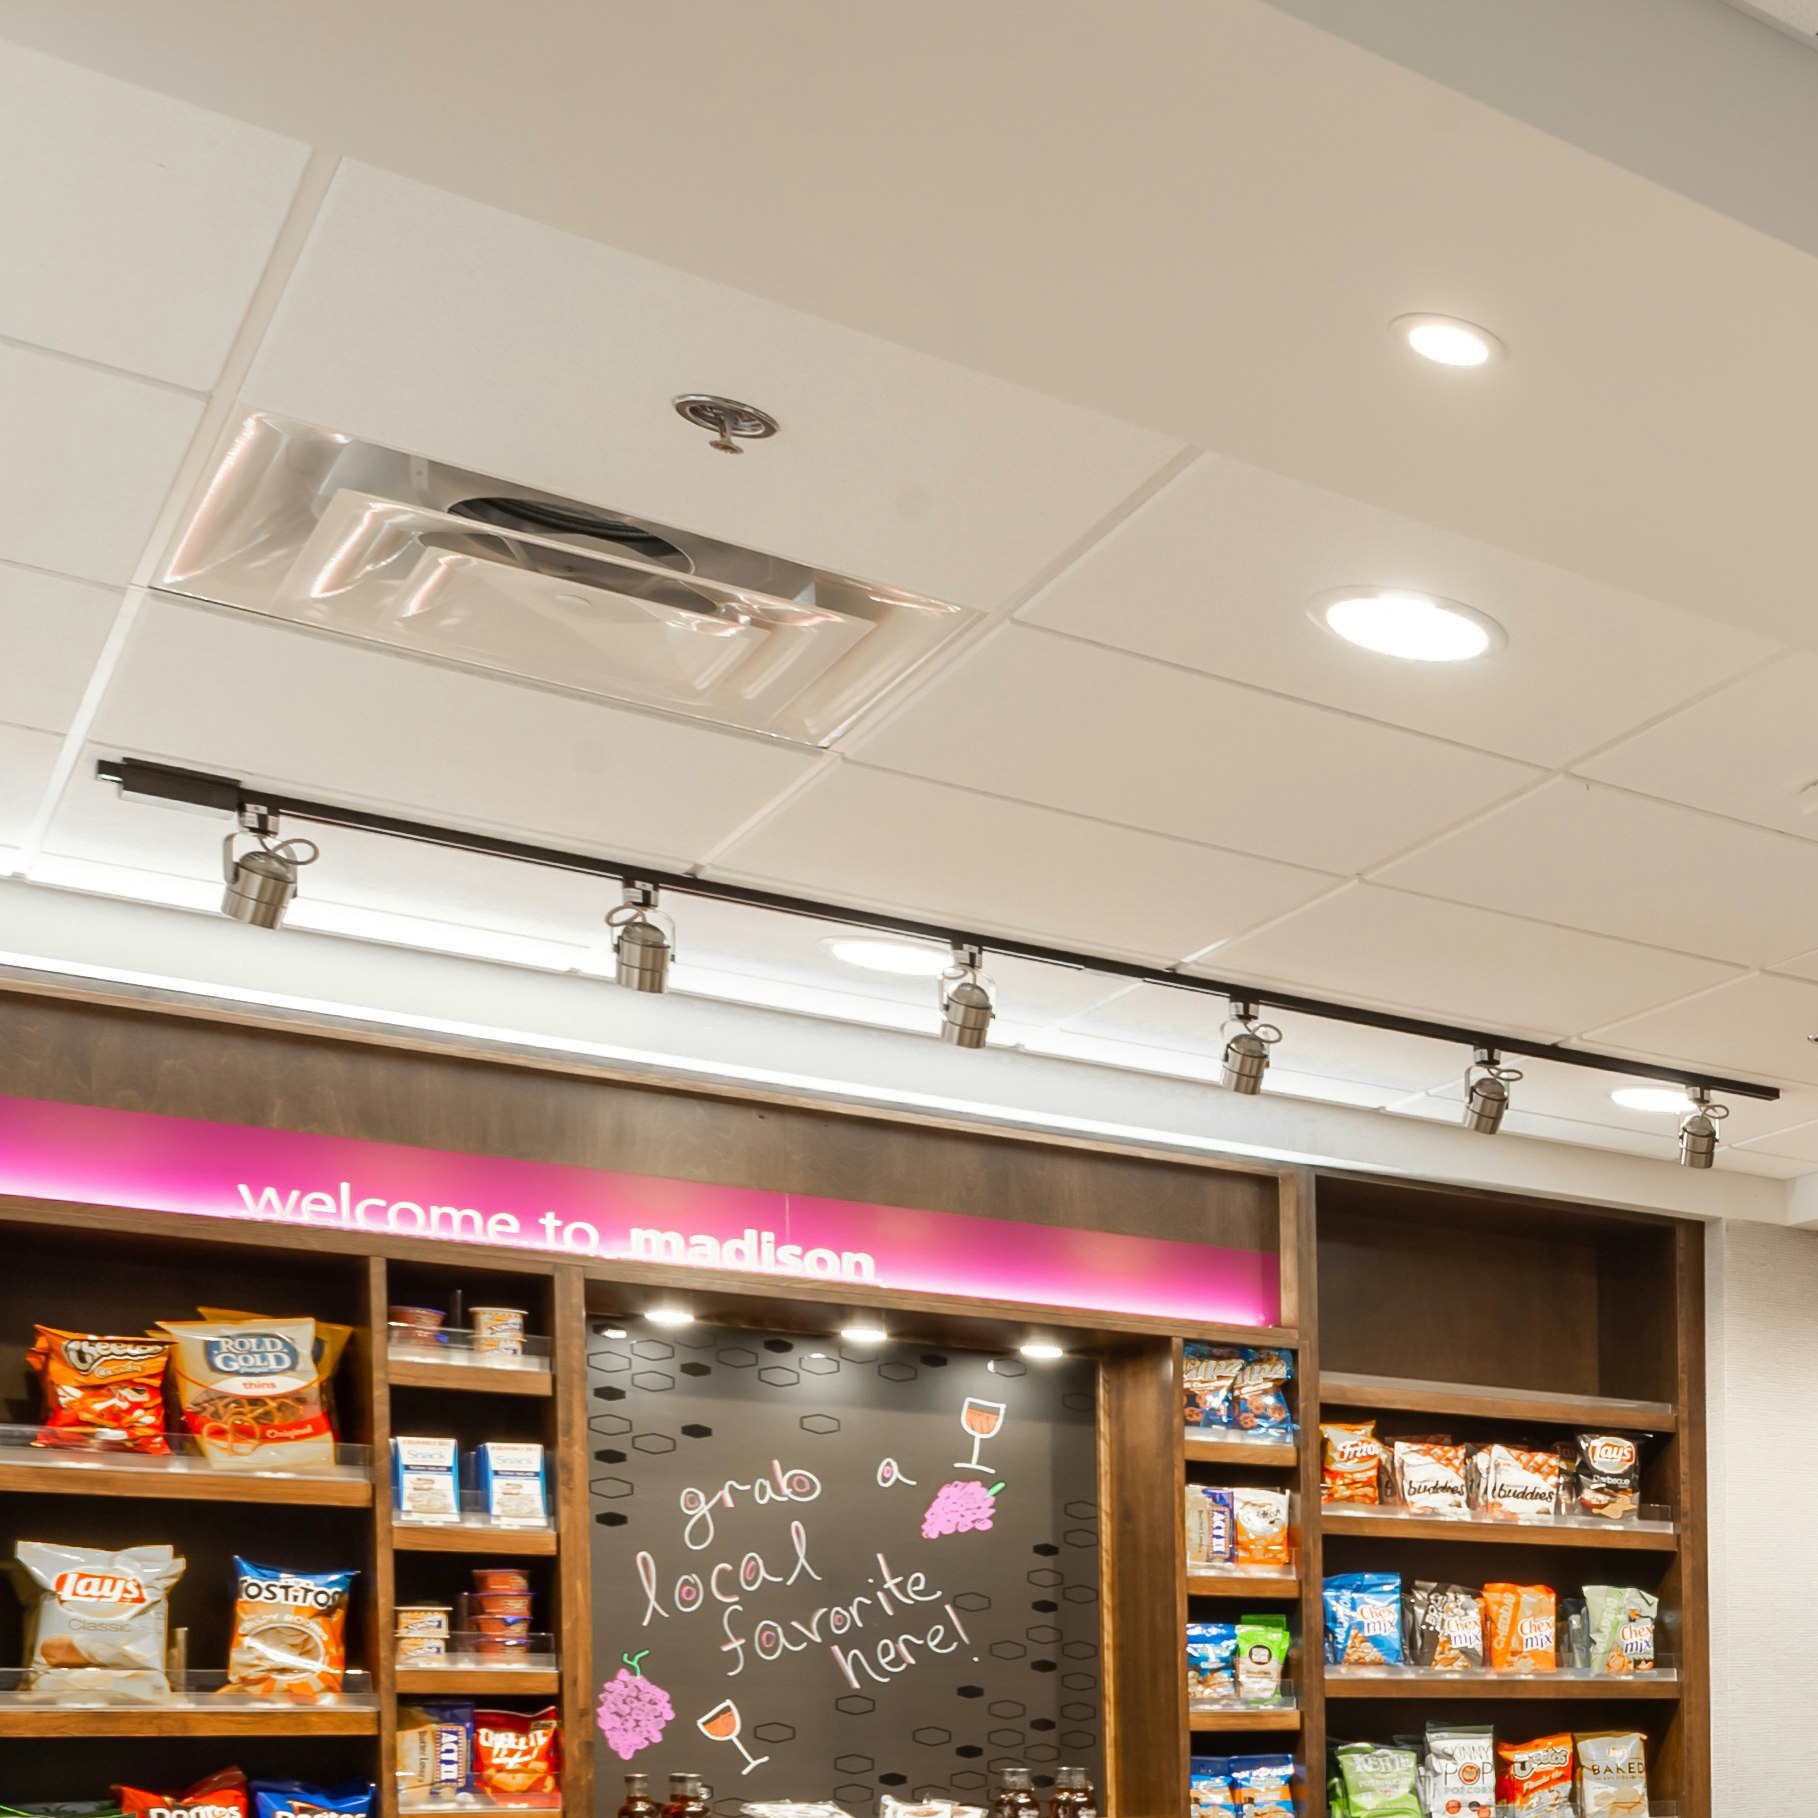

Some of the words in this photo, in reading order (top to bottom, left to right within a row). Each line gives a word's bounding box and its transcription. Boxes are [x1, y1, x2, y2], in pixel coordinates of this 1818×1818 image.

[237, 1181, 522, 1243] welcome
[538, 1210, 601, 1256] to
[629, 1226, 877, 1283] madison
[218, 1336, 286, 1353] ROLD
[213, 1350, 293, 1374] GOLD
[241, 1379, 278, 1391] thins
[265, 1423, 315, 1440] Original
[679, 1458, 822, 1551] grab
[876, 1457, 918, 1489] a
[636, 1520, 822, 1627] local
[60, 1572, 143, 1604] Lay's
[718, 1552, 943, 1677] favorite
[1359, 1605, 1395, 1620] Chex
[67, 1618, 132, 1633] Classic
[1365, 1619, 1396, 1634] mix
[1446, 1617, 1480, 1633] Chex
[1519, 1617, 1554, 1636] Chex
[1620, 1624, 1653, 1642] Chex
[830, 1603, 980, 1690] here!
[1453, 1631, 1481, 1646] mix
[1524, 1634, 1553, 1650] mix
[1624, 1639, 1652, 1655] mix
[440, 1731, 459, 1761] ACT
[1591, 1761, 1645, 1776] BAKED
